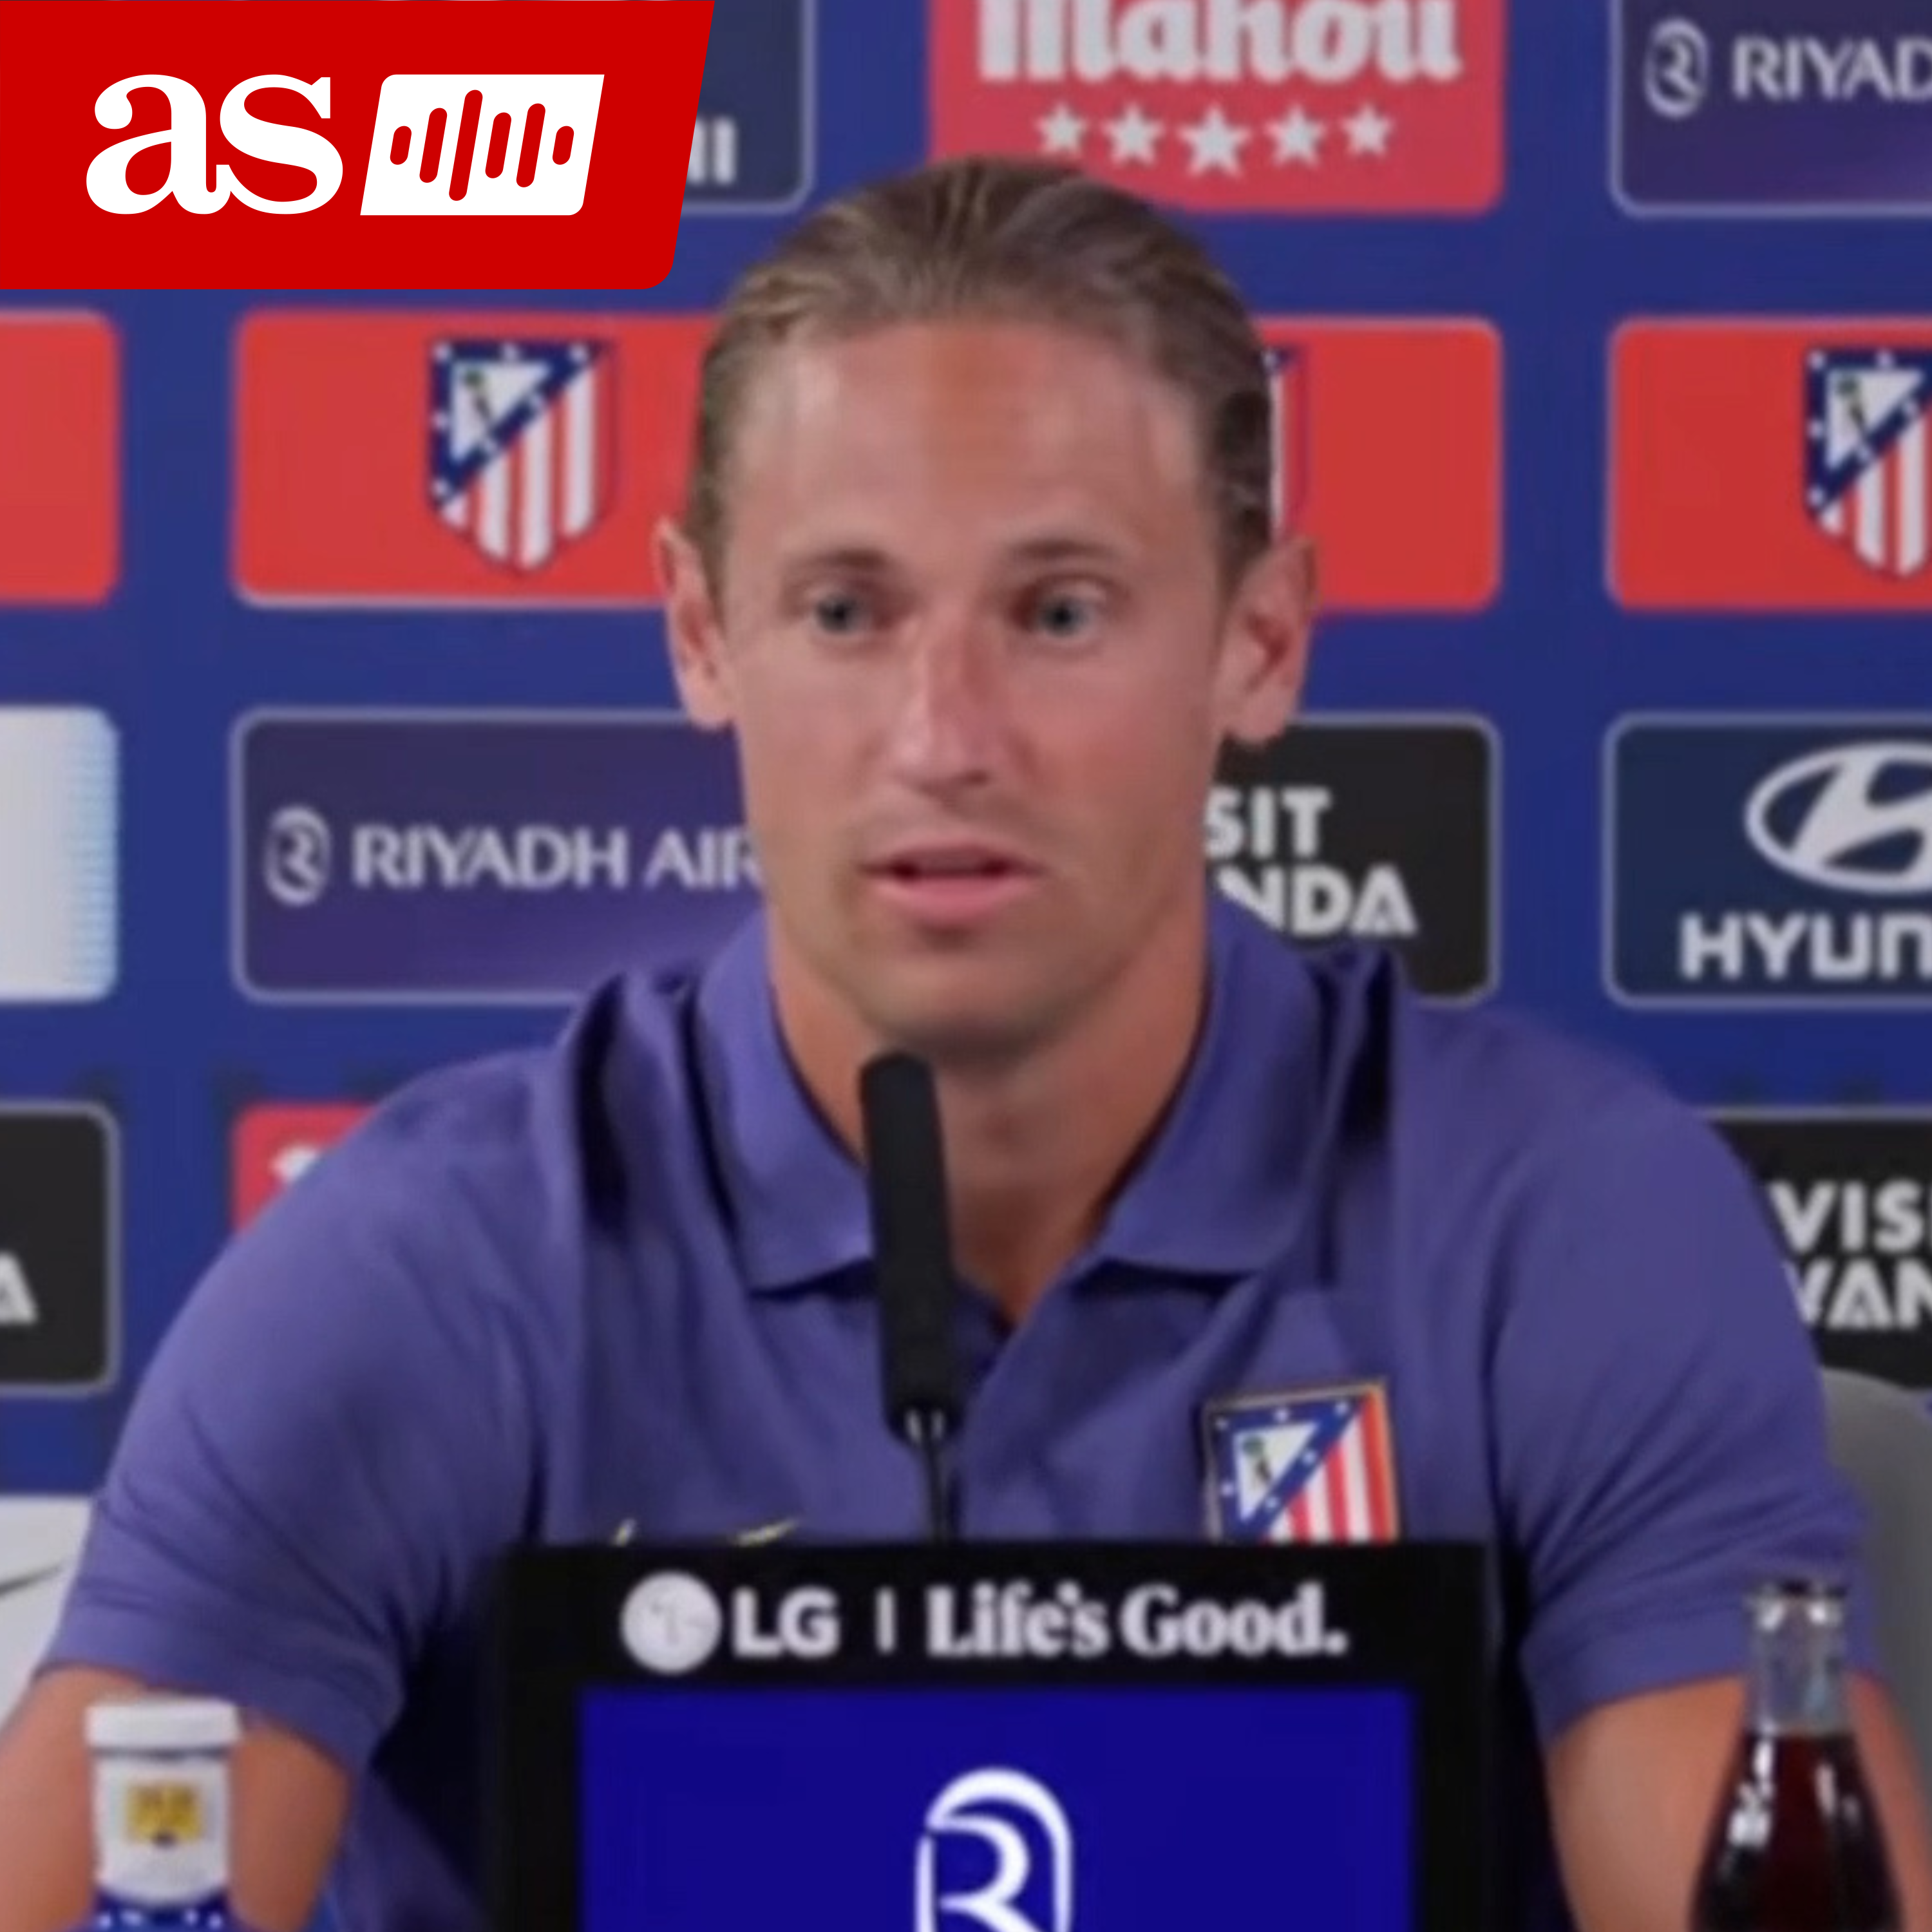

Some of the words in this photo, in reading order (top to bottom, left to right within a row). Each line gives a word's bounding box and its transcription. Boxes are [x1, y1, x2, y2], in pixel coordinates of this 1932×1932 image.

[352, 825, 629, 889] RIYADH
[645, 827, 762, 889] AIR
[1204, 786, 1331, 860] SIT
[1215, 864, 1416, 936] NDA
[1768, 1180, 1932, 1253] VIS
[733, 1587, 840, 1657] LG
[927, 1581, 1110, 1657] Life's
[1119, 1582, 1348, 1656] Good.
